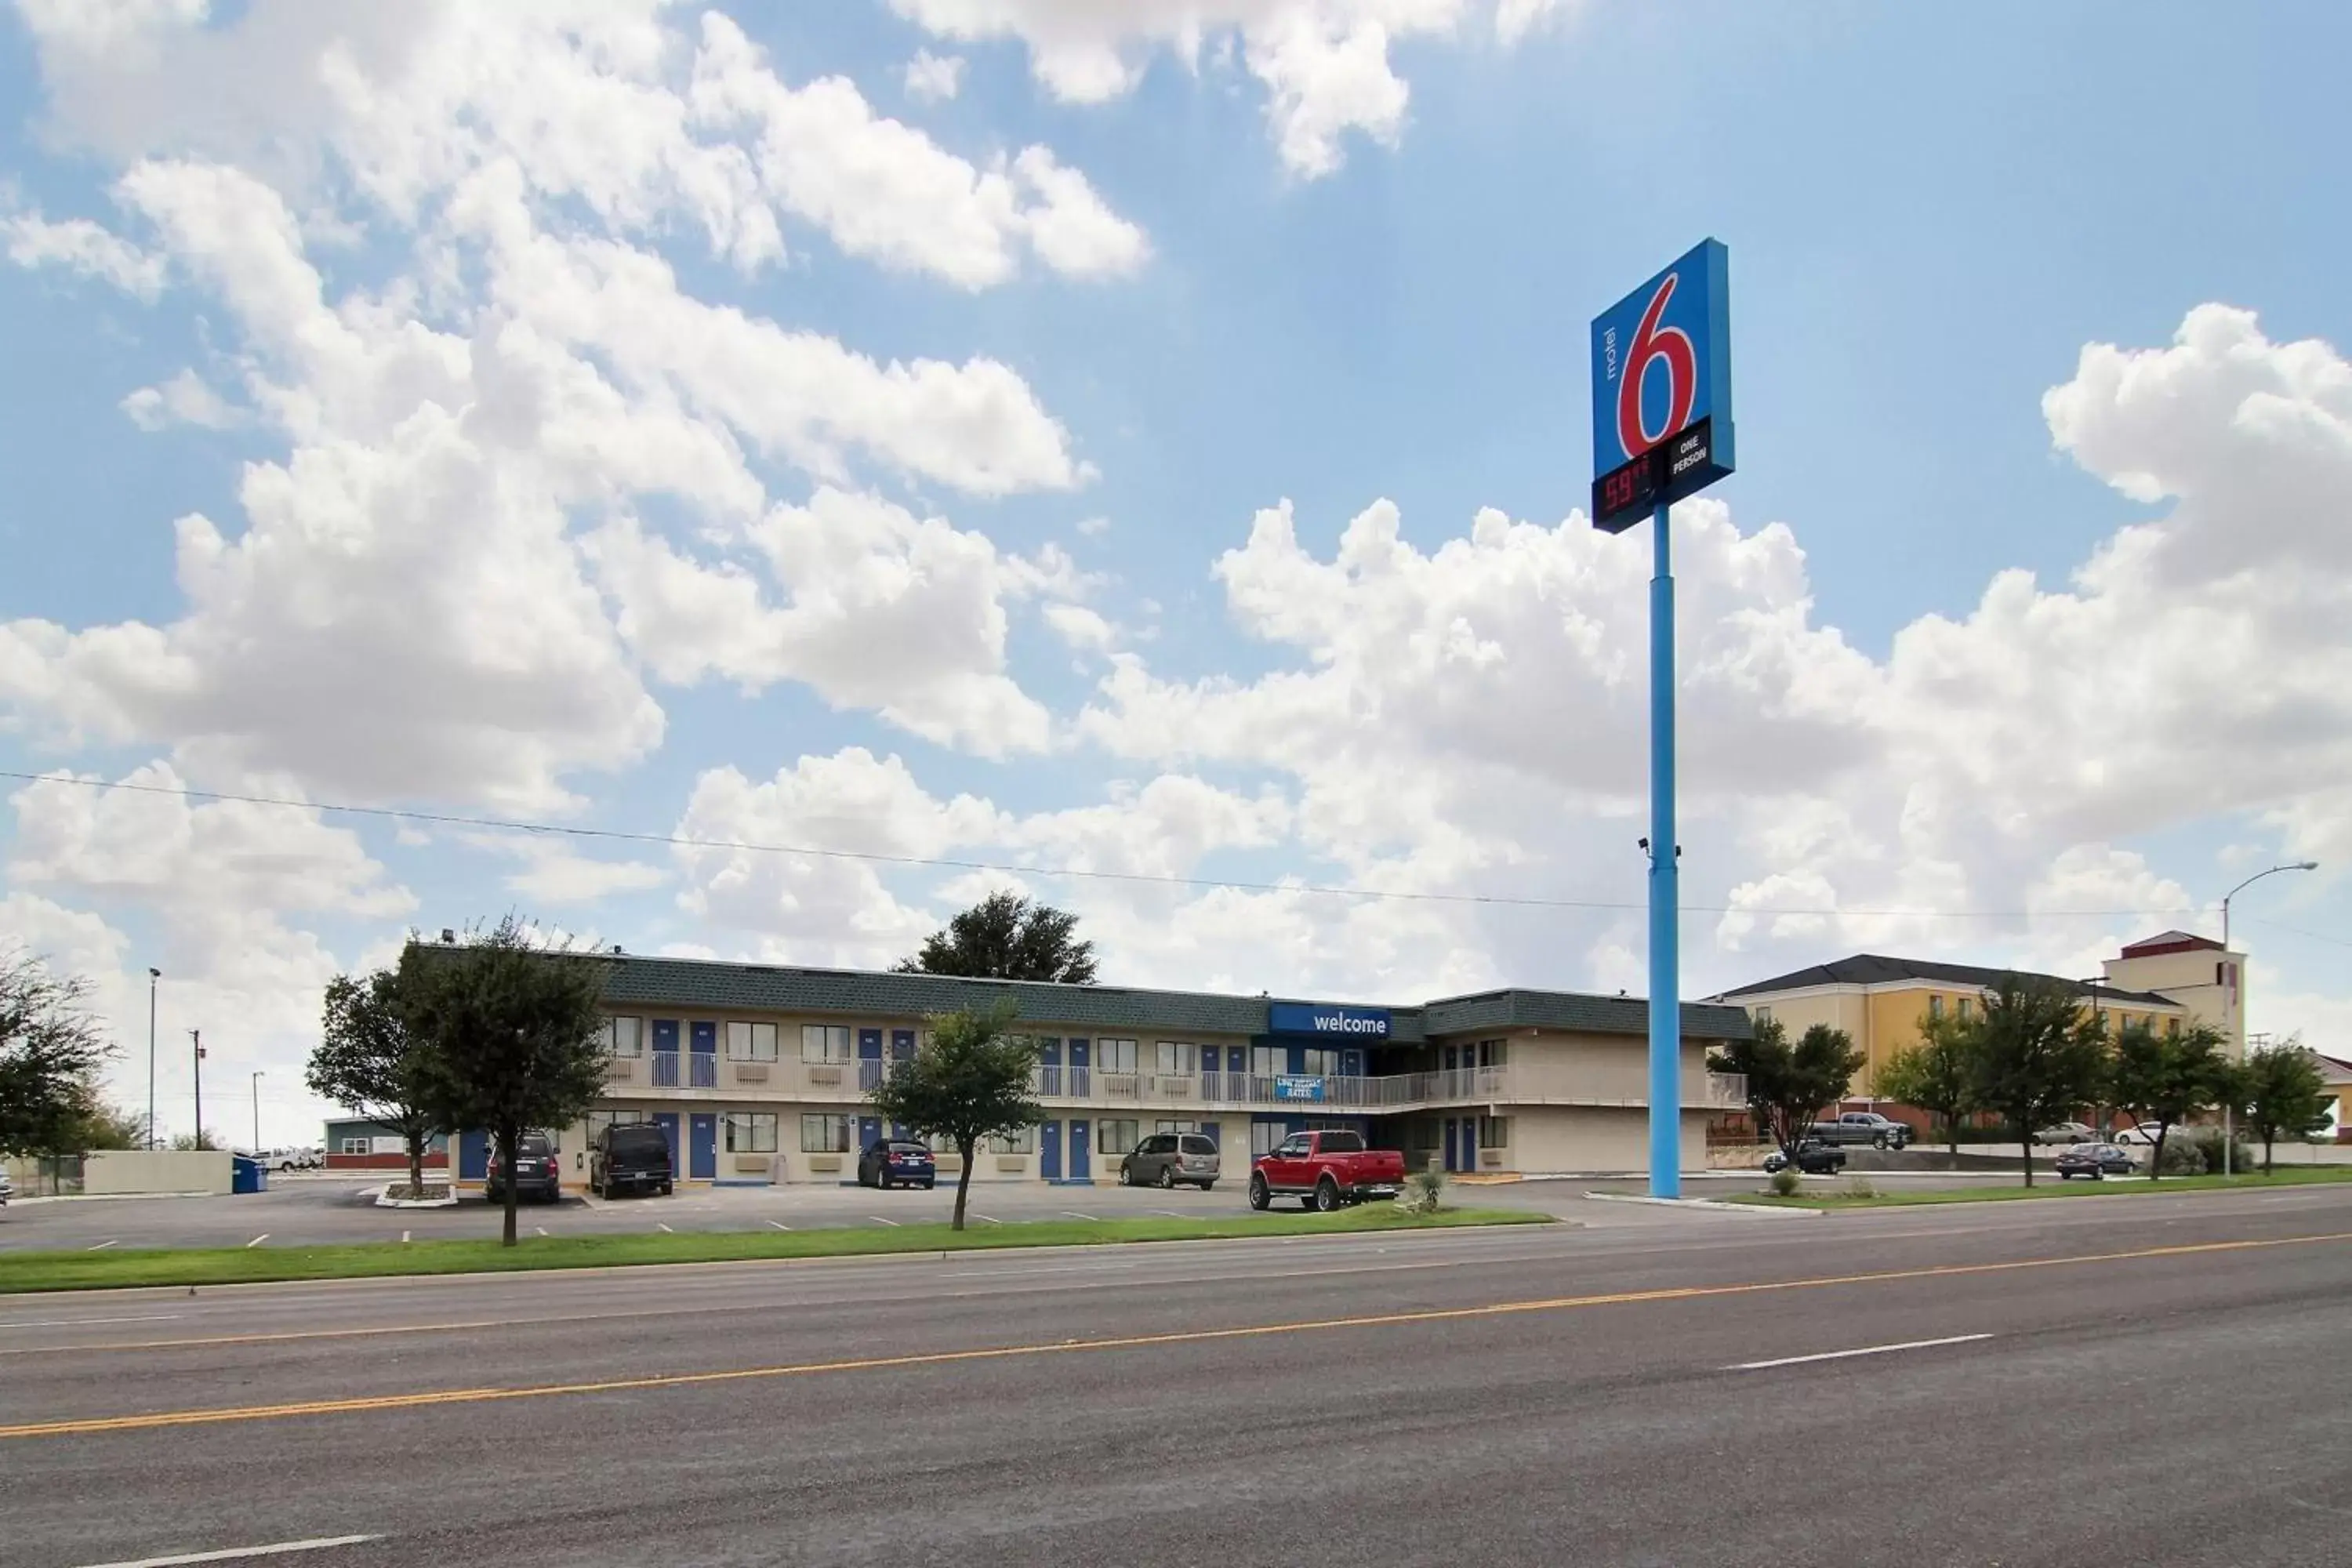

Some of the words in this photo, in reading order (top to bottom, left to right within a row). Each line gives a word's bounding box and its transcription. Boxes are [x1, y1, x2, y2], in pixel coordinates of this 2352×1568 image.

[1603, 326, 1616, 381] motel
[1617, 272, 1696, 459] 6
[1680, 435, 1699, 454] ONE
[1673, 446, 1707, 474] PERSON
[1314, 1011, 1386, 1034] welcome
